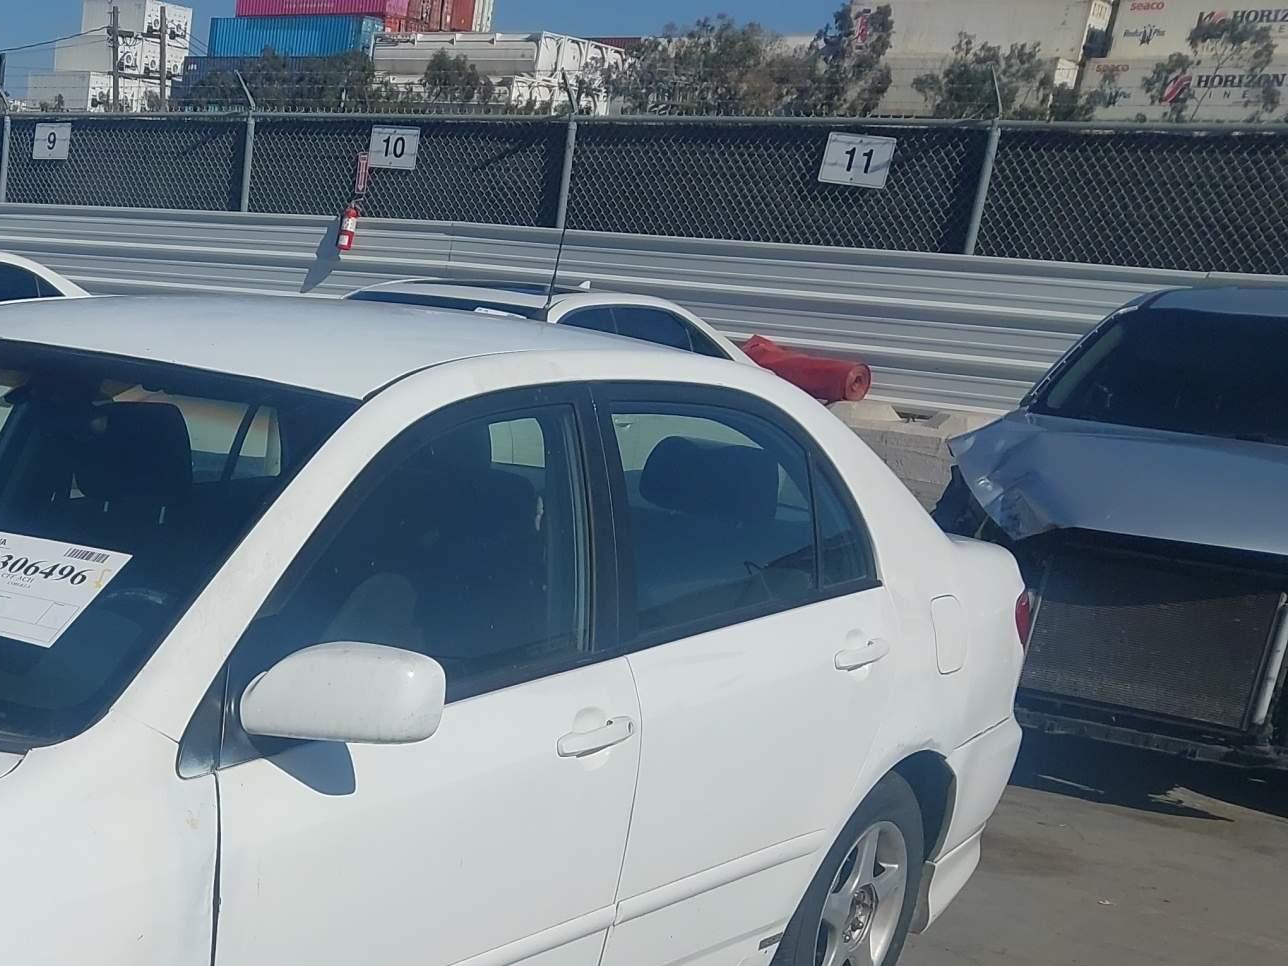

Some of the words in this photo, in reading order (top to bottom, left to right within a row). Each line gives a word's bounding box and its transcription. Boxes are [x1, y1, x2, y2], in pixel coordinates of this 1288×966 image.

[1130, 1, 1165, 12] seaco
[1197, 73, 1287, 88] HORIZON
[47, 131, 57, 150] 9
[383, 135, 406, 158] 10
[845, 146, 874, 174] 11
